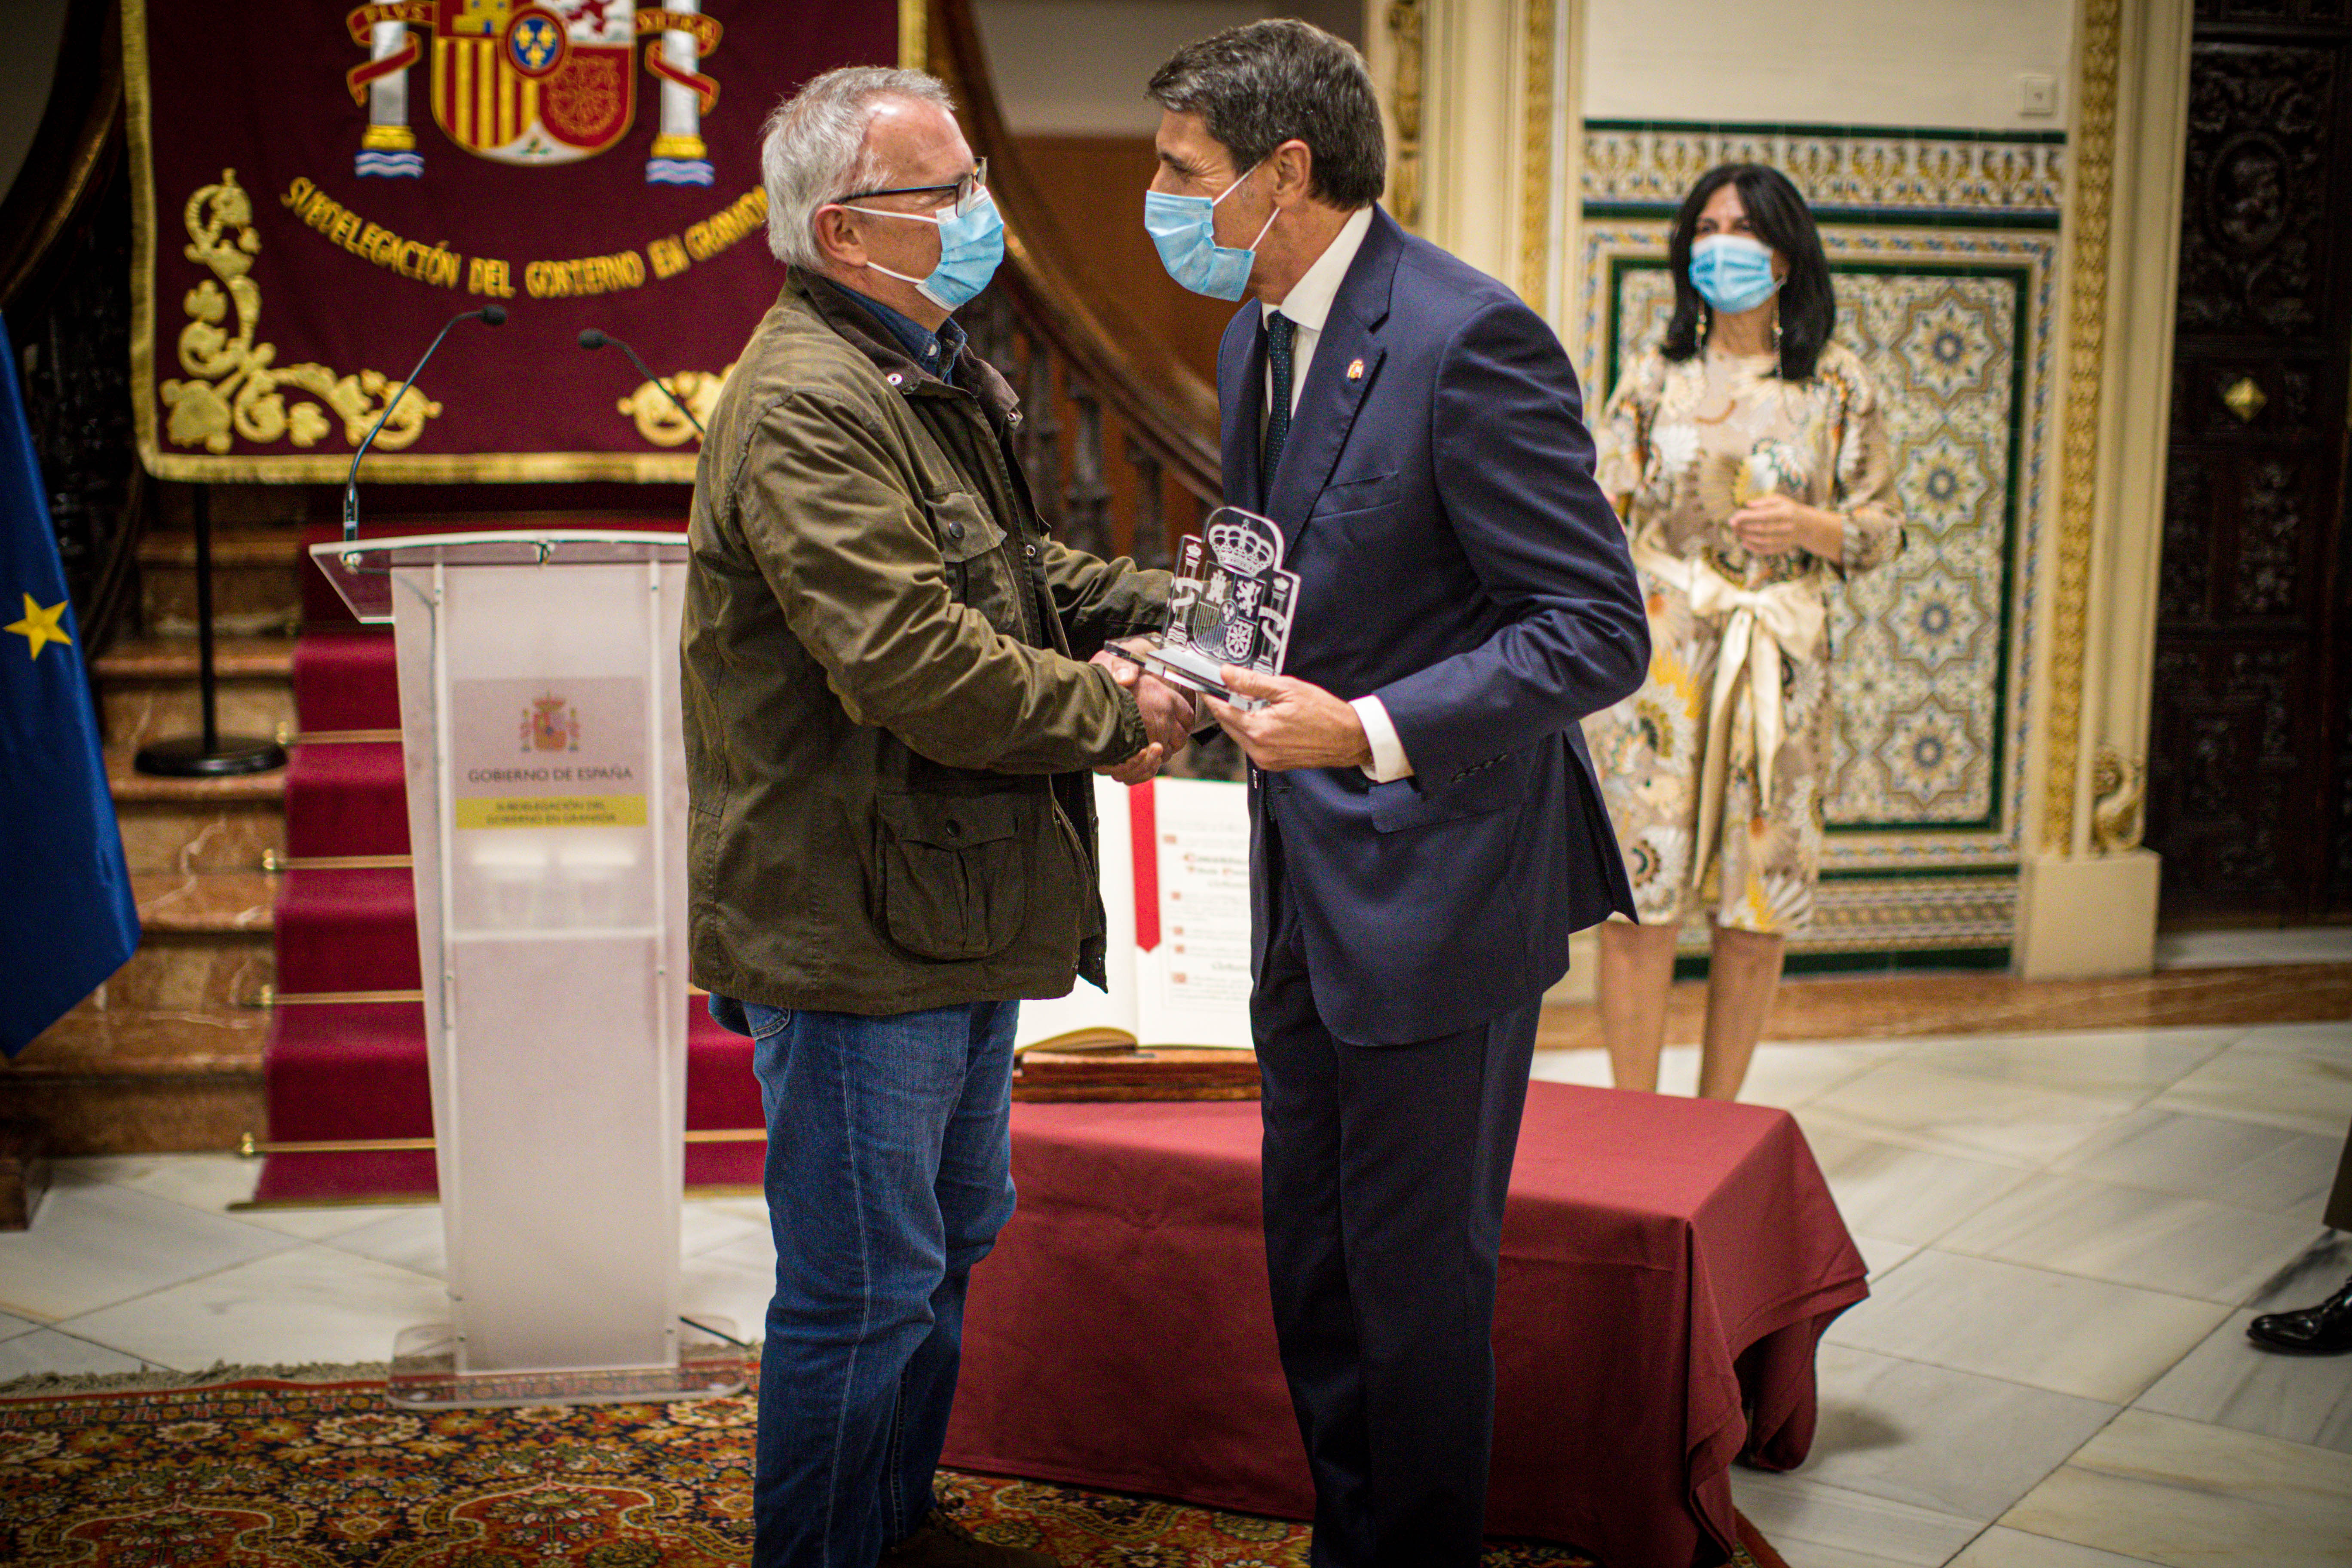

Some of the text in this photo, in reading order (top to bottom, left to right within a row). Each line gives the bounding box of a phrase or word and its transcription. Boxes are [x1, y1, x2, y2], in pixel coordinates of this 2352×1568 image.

[280, 176, 461, 288] SUBDELEGACIÓN
[468, 257, 516, 299] DEL
[525, 250, 645, 298] GOBIERNO
[647, 234, 691, 279] EN
[468, 763, 633, 783] GOBIERNO DE ESPAÑA
